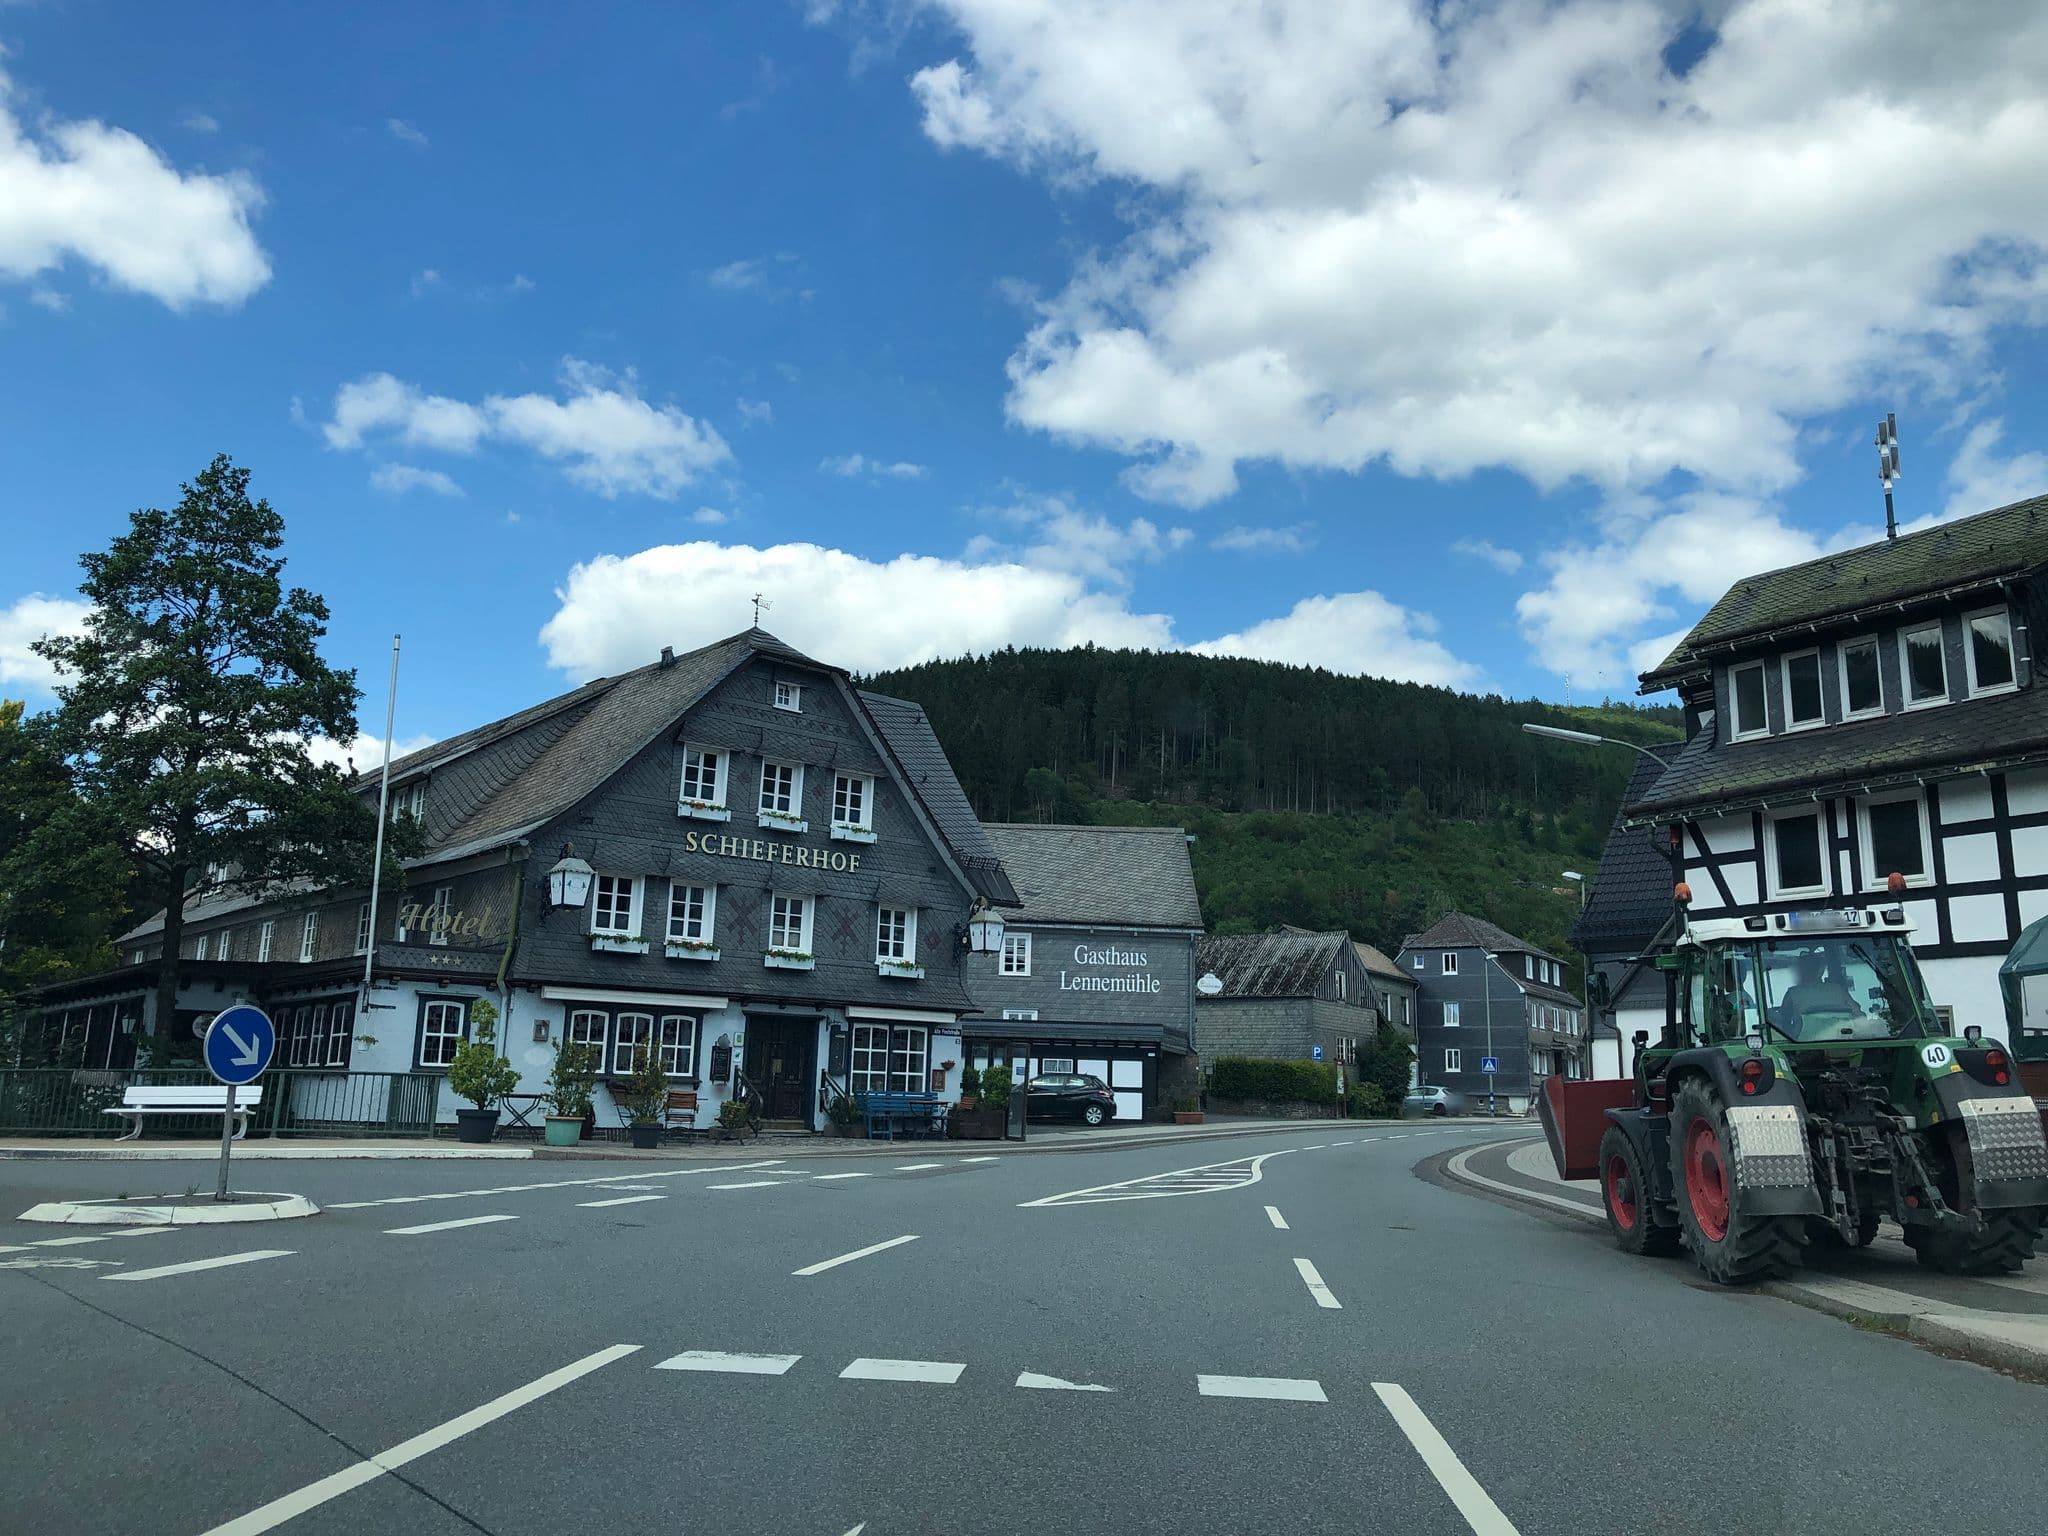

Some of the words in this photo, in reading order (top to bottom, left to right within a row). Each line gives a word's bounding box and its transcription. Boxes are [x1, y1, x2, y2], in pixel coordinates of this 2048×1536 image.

[685, 831, 860, 873] SCHIEFERHOF
[400, 903, 494, 937] Hotel
[1074, 944, 1148, 966] Gasthaus
[1059, 970, 1161, 993] Lennemühle
[1927, 1047, 1946, 1064] 40
